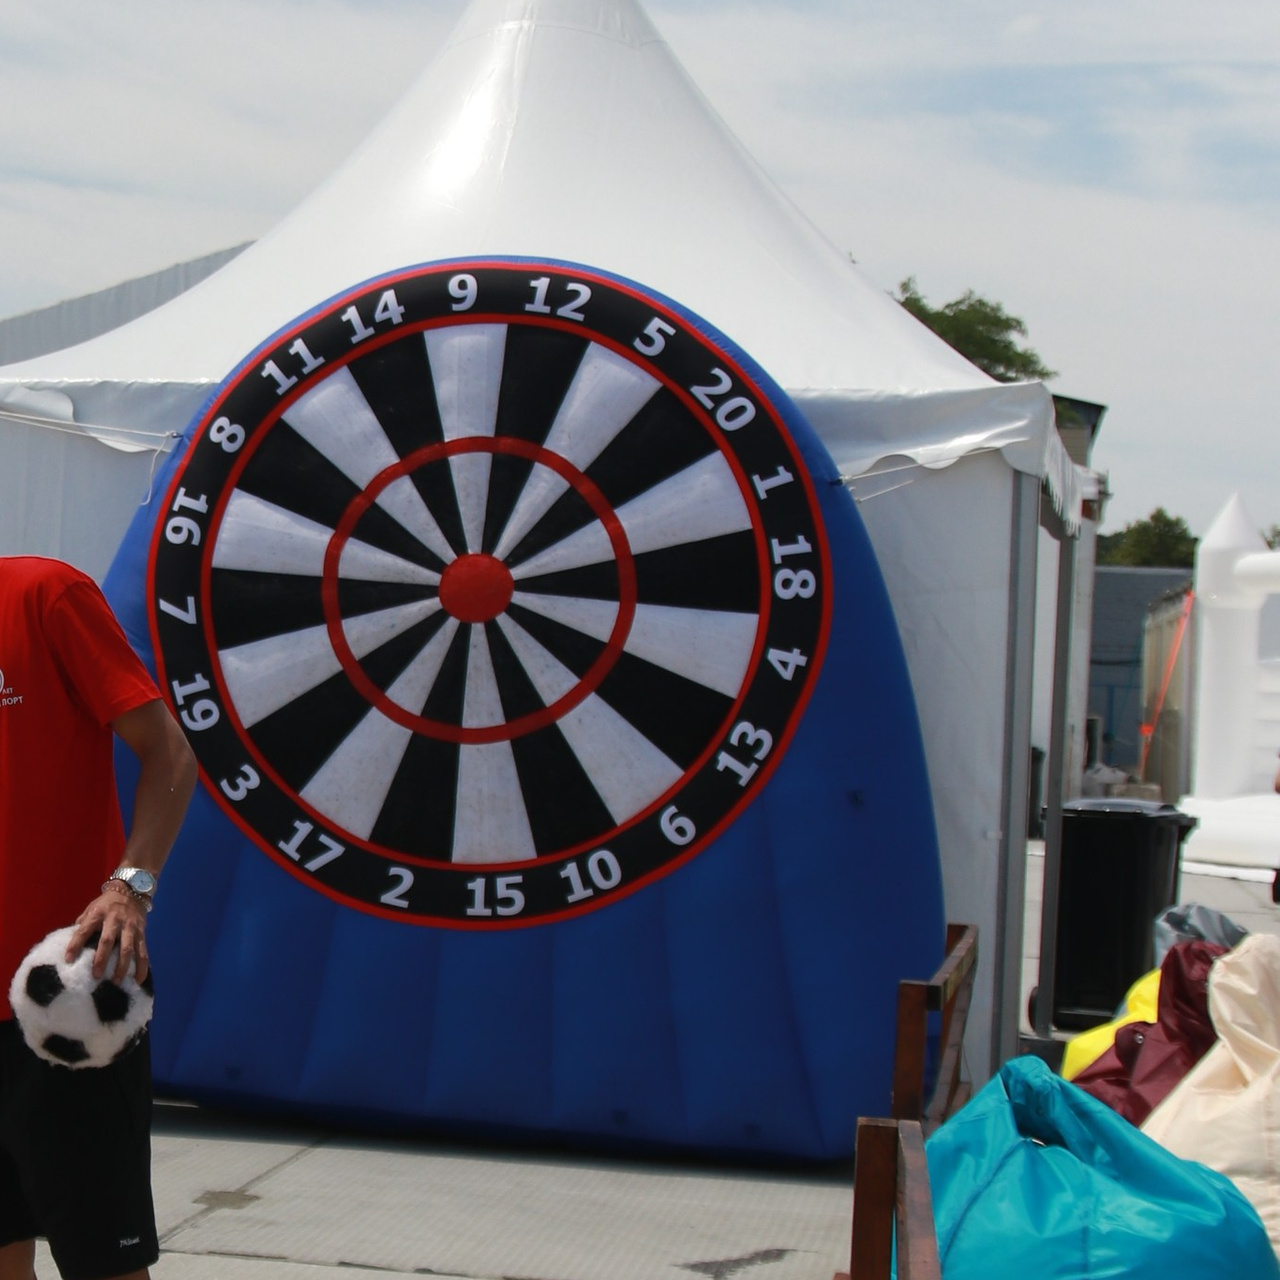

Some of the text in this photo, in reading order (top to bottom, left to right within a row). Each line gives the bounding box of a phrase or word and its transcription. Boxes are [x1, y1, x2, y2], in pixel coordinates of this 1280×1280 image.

[447, 273, 478, 311] 9
[525, 276, 592, 321] 12
[340, 288, 405, 344] 14
[633, 316, 677, 356] 5
[260, 337, 325, 395] 11
[690, 367, 756, 431] 20
[209, 416, 246, 453] 8
[752, 463, 795, 501] 1
[165, 486, 209, 548] 16
[771, 533, 816, 601] 18
[158, 595, 197, 625] 7
[767, 646, 808, 682] 4
[172, 672, 220, 732] 19
[717, 721, 773, 787] 13
[220, 764, 261, 801] 3
[278, 820, 345, 872] 17
[660, 805, 696, 846] 6
[380, 867, 414, 908] 2
[466, 875, 525, 916] 15
[560, 850, 622, 903] 10
